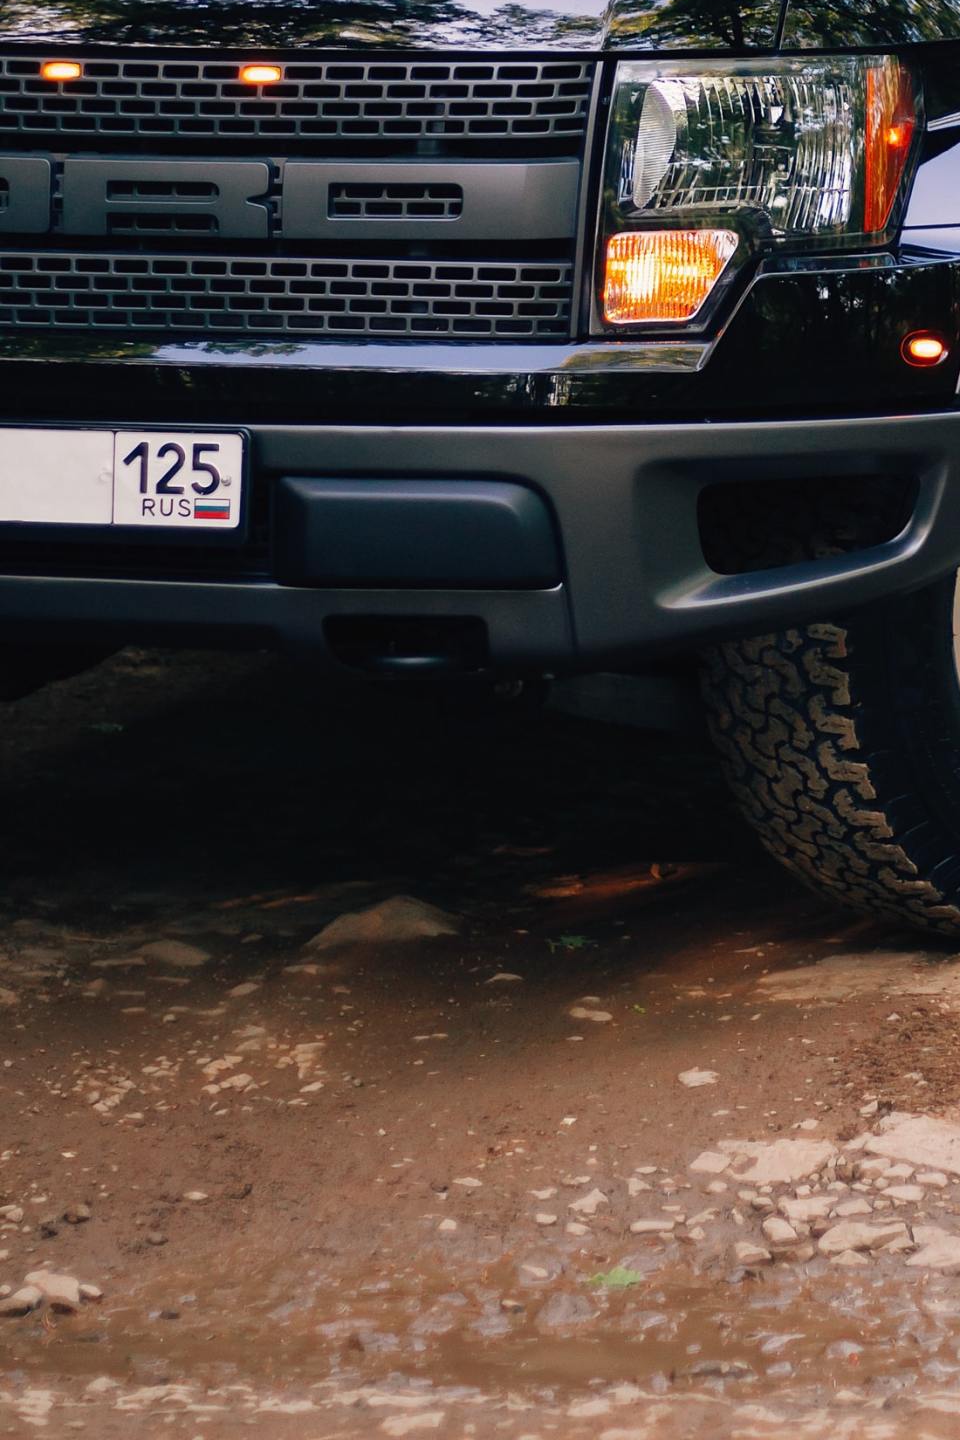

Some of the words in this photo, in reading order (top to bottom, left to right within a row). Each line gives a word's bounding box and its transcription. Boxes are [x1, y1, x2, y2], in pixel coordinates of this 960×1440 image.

[0, 157, 580, 240] RD
[122, 441, 221, 496] 125
[141, 498, 191, 518] RUS
